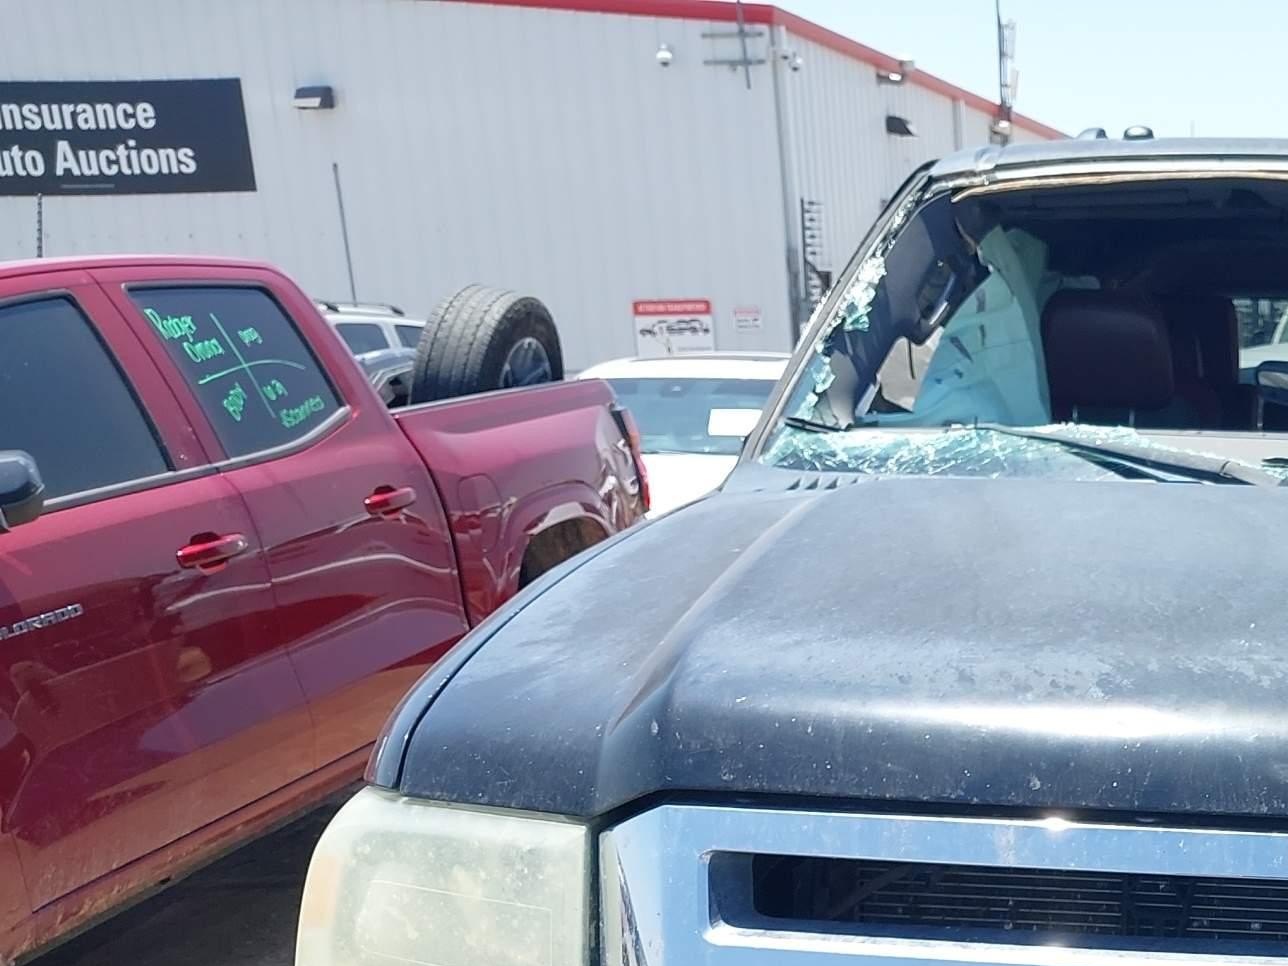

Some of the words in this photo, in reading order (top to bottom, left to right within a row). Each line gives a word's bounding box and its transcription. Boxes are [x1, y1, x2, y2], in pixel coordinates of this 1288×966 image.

[0, 101, 157, 131] nsurance
[0, 144, 46, 177] uto
[55, 139, 198, 177] Auctions
[0, 602, 84, 640] LORADO
